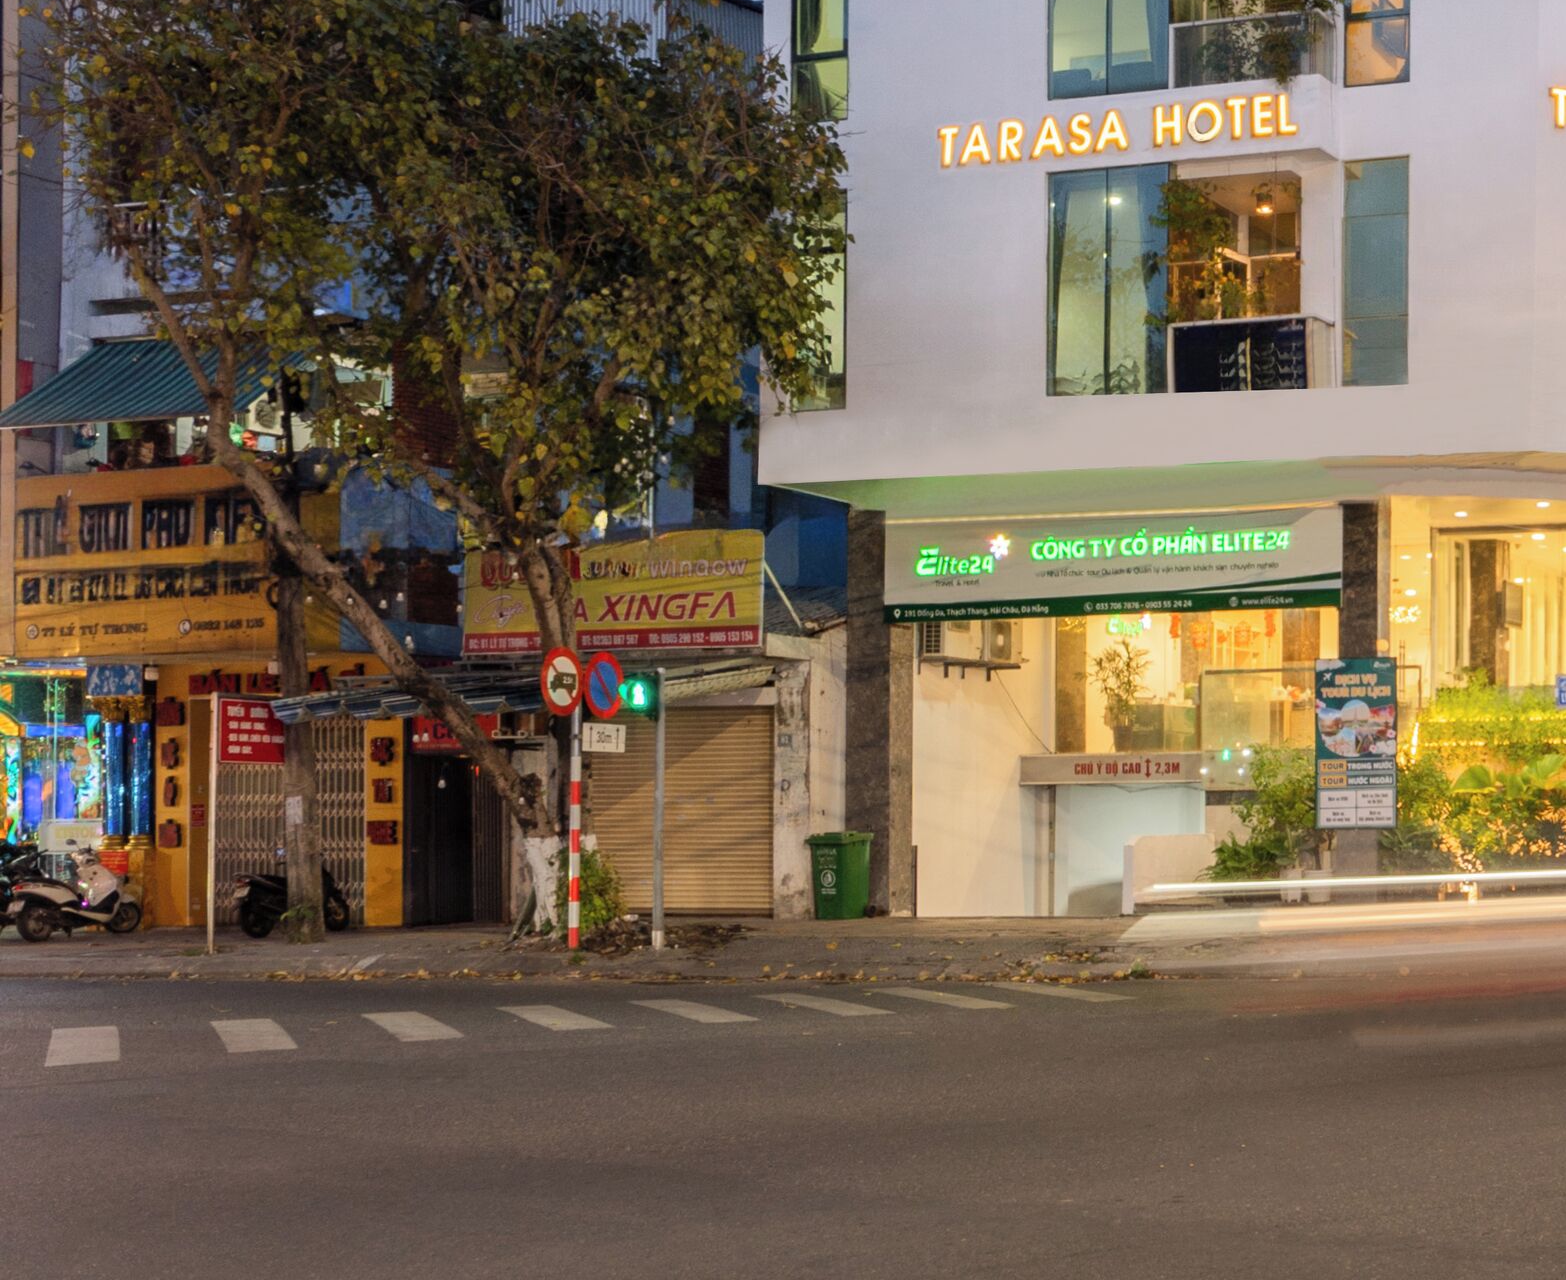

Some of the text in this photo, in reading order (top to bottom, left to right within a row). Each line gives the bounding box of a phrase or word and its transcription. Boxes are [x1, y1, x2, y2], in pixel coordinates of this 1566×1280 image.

[937, 92, 1297, 168] TARASA HOTEL
[1031, 527, 1290, 561] CÔNG TY CỔ PHẦN ELITE24
[1074, 760, 1093, 775] CHÚ
[1122, 762, 1141, 774] CAO
[1155, 762, 1180, 776] 2,3M
[1322, 762, 1344, 770] TOUR
[1322, 777, 1344, 785] TOUR
